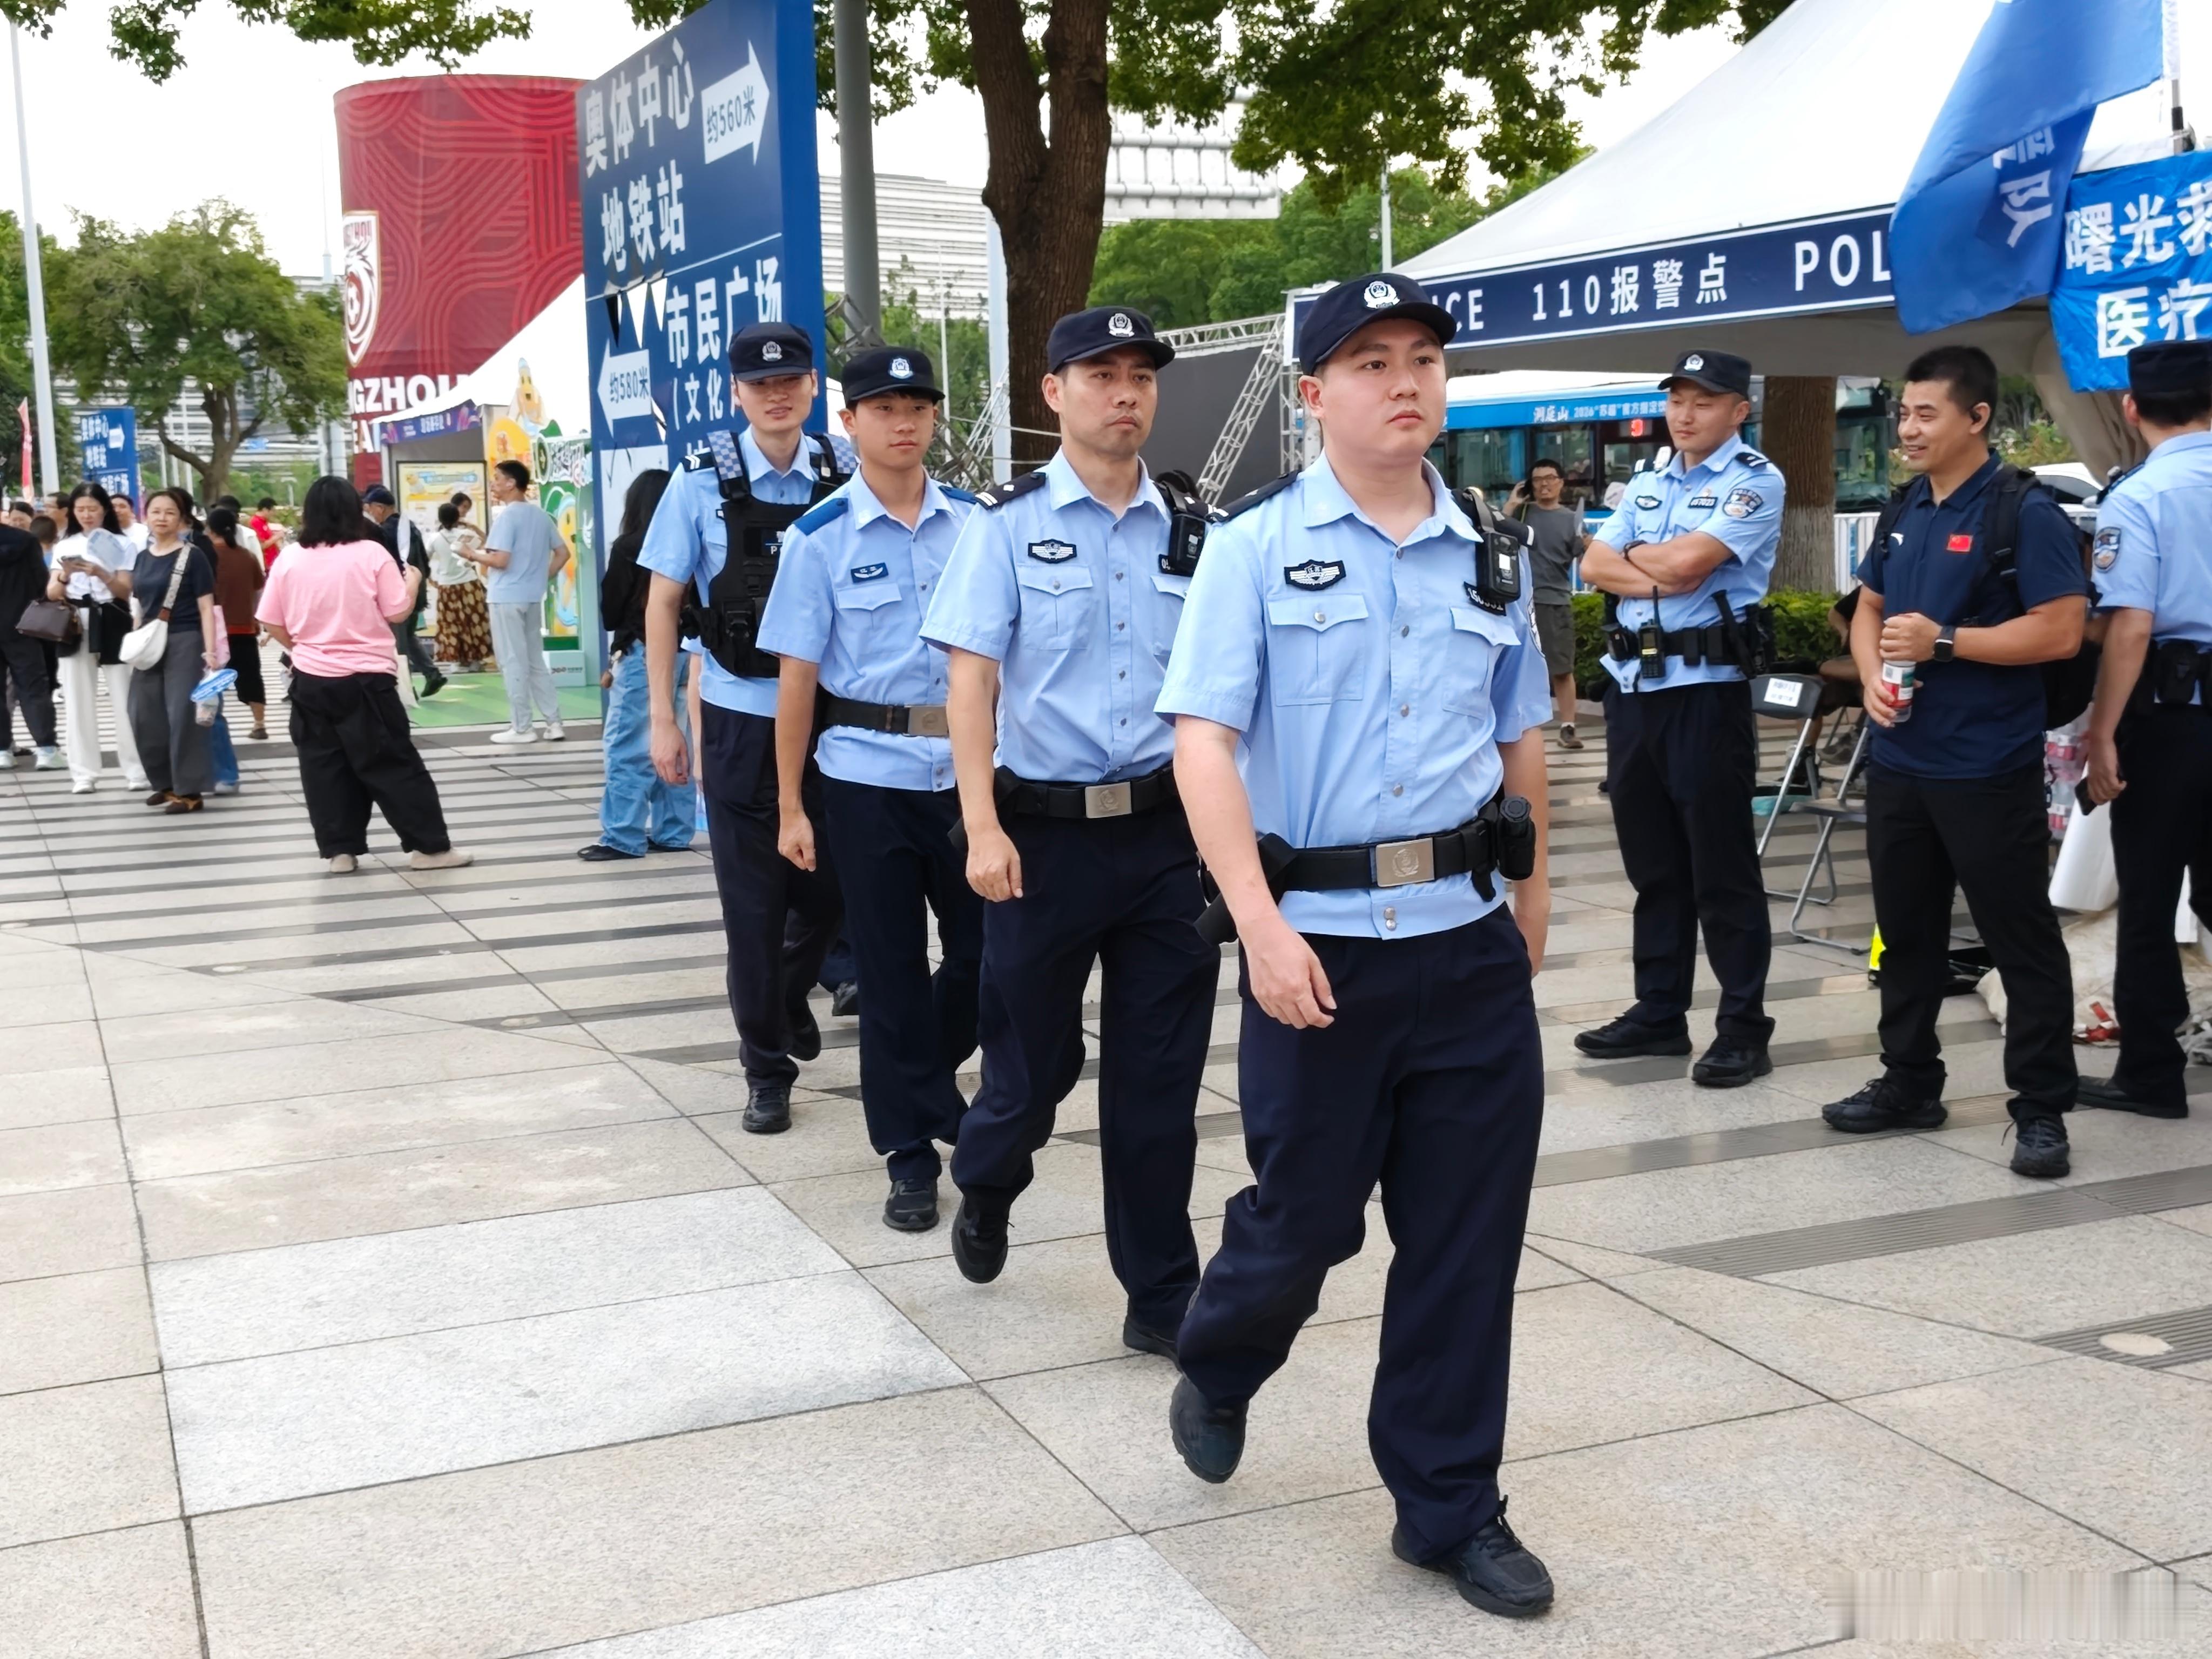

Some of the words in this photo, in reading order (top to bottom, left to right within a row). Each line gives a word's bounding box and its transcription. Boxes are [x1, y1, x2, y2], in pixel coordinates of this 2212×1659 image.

[586, 37, 694, 179] 奥体中心
[707, 85, 756, 144] 约560米
[602, 159, 686, 273] 地铁站
[666, 256, 783, 369] 市民广场
[1432, 288, 1484, 332] CE
[2096, 278, 2212, 359] 医疗
[609, 366, 649, 403] 约580米
